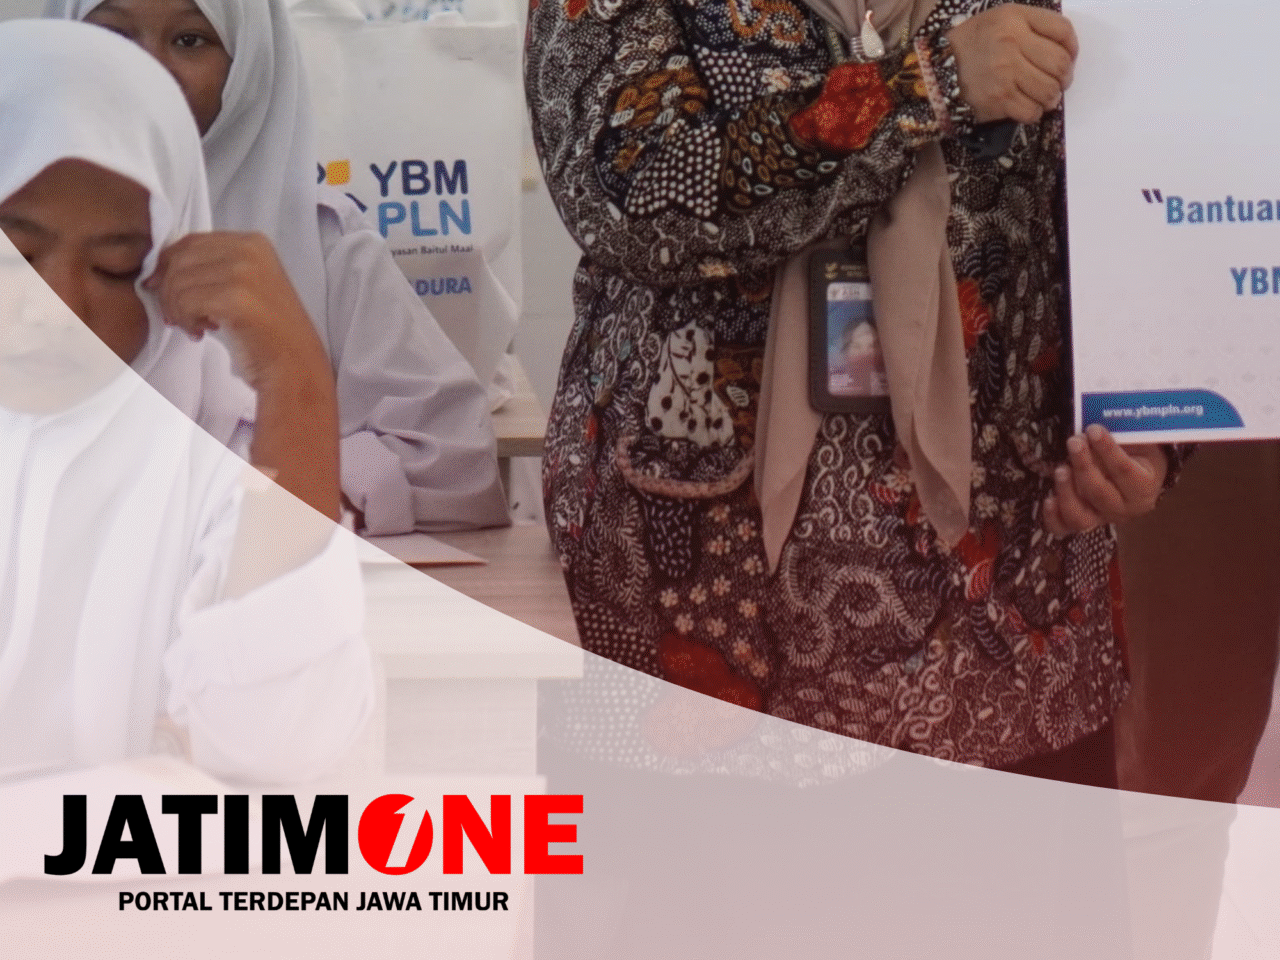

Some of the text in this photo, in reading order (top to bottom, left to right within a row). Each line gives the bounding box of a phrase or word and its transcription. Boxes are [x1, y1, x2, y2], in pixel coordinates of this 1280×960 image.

[369, 159, 469, 197] YBM
[378, 199, 472, 239] PLN
[413, 276, 473, 296] DURA
[1103, 404, 1204, 419] www.ybmpln.org
